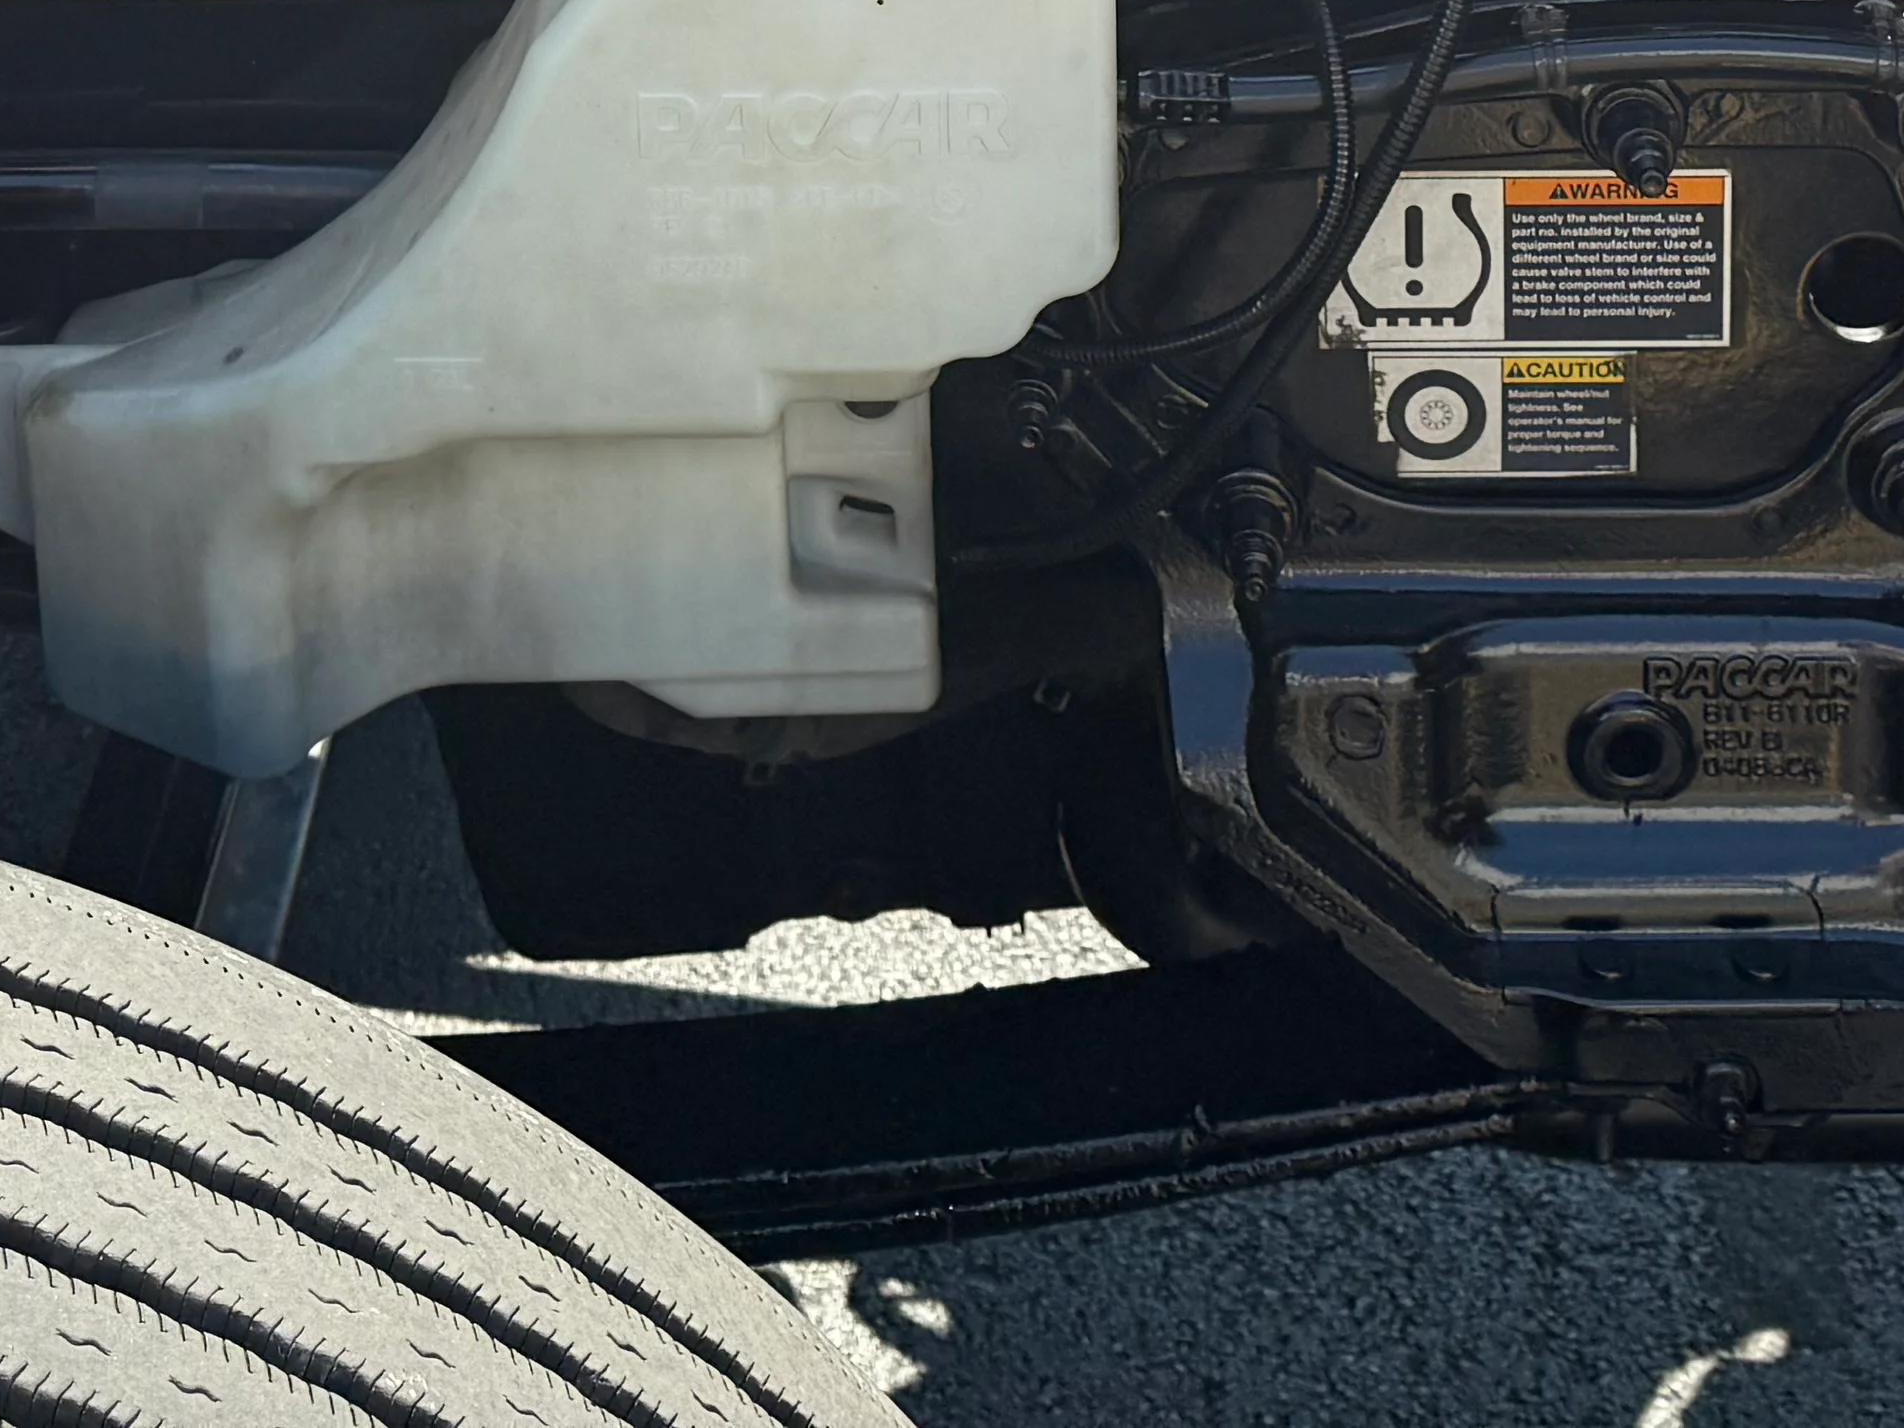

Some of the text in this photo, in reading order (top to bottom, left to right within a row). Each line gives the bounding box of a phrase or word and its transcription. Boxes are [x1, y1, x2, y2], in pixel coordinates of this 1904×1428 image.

[636, 86, 1015, 163] PACCAR
[1570, 183, 1678, 199] WARNG
[1513, 214, 1535, 223] Use
[1538, 214, 1563, 225] only
[1567, 214, 1586, 223] the
[1589, 213, 1624, 223] wheel
[1627, 213, 1665, 224] brand,
[1669, 213, 1692, 223] size
[1512, 227, 1700, 238] part no. installed by the original
[1512, 241, 1574, 251] equipment
[1578, 241, 1660, 250] manufacturer.
[1664, 241, 1687, 249] Use
[1690, 241, 1702, 249] of
[1512, 254, 1562, 263] different
[1565, 254, 1600, 263] wheel
[1603, 254, 1637, 263] brand
[1657, 254, 1679, 263] size
[1683, 254, 1716, 263] could
[1551, 267, 1582, 276] valve
[1585, 268, 1614, 276] stem
[1617, 268, 1629, 276] to
[1632, 267, 1681, 276] interfere
[1685, 267, 1710, 276] with
[1523, 281, 1556, 290] brake
[1559, 281, 1626, 291] component
[1629, 281, 1664, 289] which
[1667, 281, 1700, 289] could
[1513, 294, 1711, 303] lead to loss of vehicle control and
[1513, 307, 1675, 318] may lead to personal injury.
[1526, 362, 1625, 378] CAUTION
[1642, 653, 1858, 700] PACCAR
[1703, 730, 1751, 750] REV
